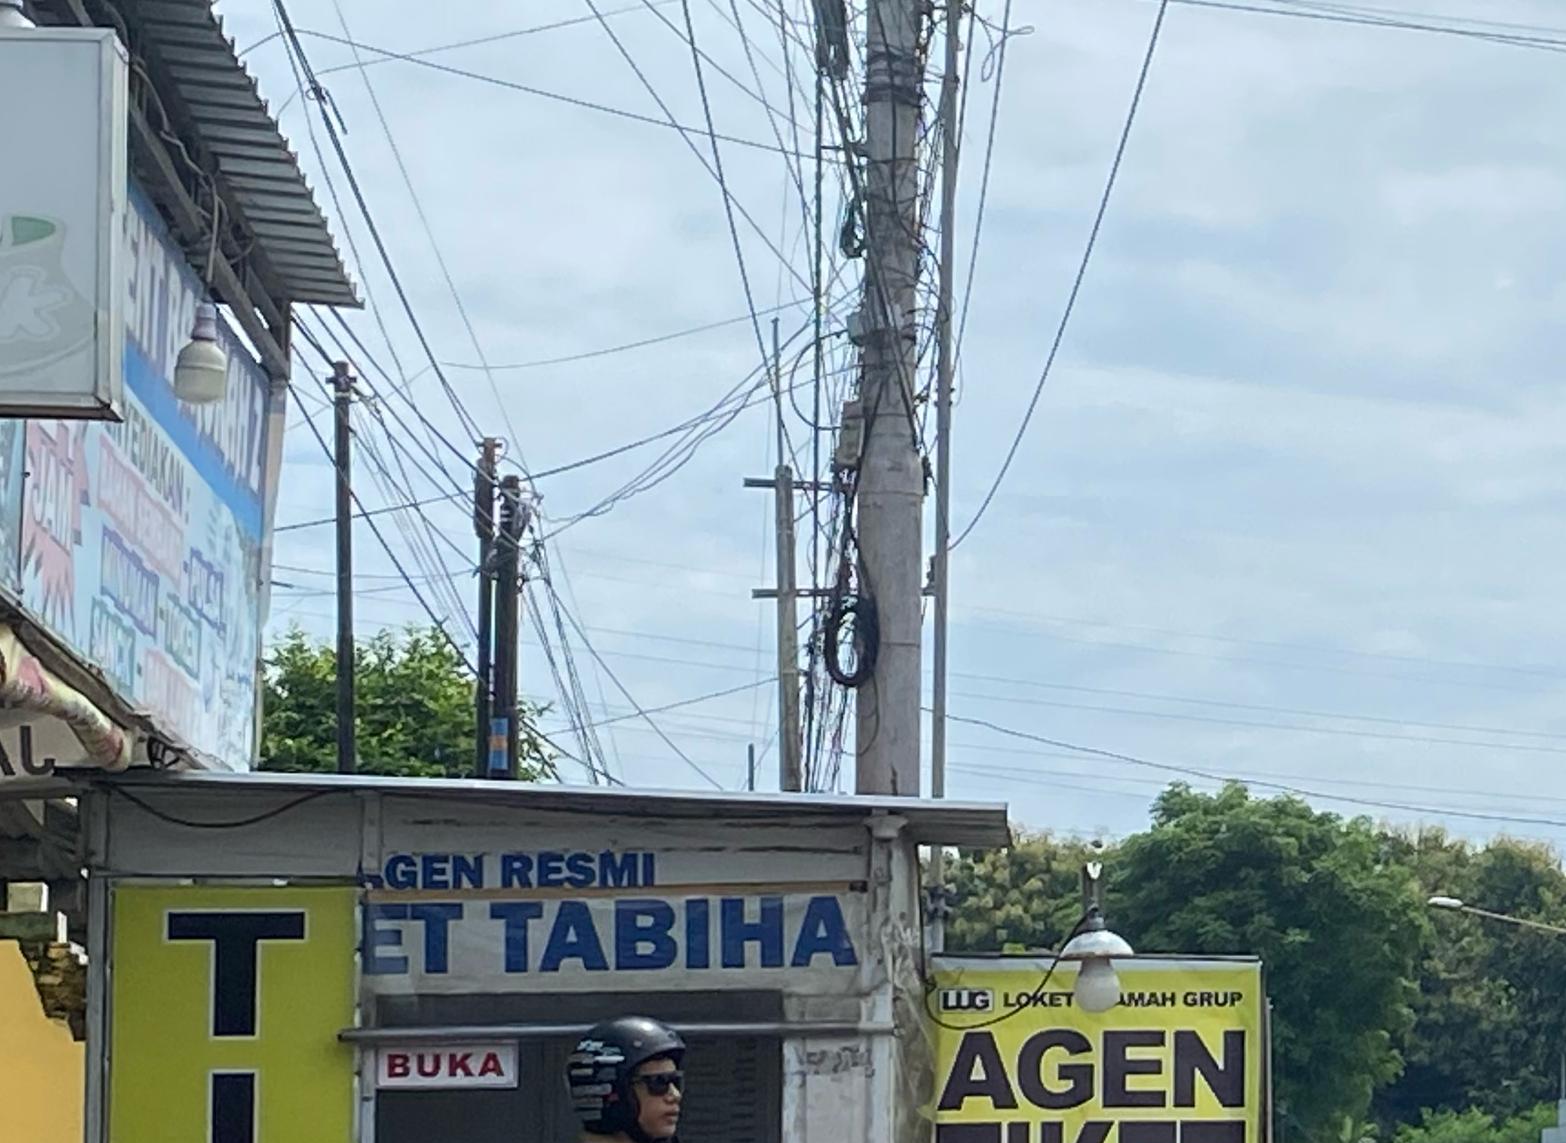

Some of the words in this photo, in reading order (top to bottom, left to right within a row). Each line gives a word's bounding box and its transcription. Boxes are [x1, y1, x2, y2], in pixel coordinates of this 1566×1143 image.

[363, 851, 484, 889] GEN
[501, 850, 655, 888] RESMI
[489, 896, 859, 973] TABIHA
[1183, 991, 1244, 1008] GRUP
[387, 1052, 505, 1079] BUKA
[937, 1029, 1246, 1111] AGEN
